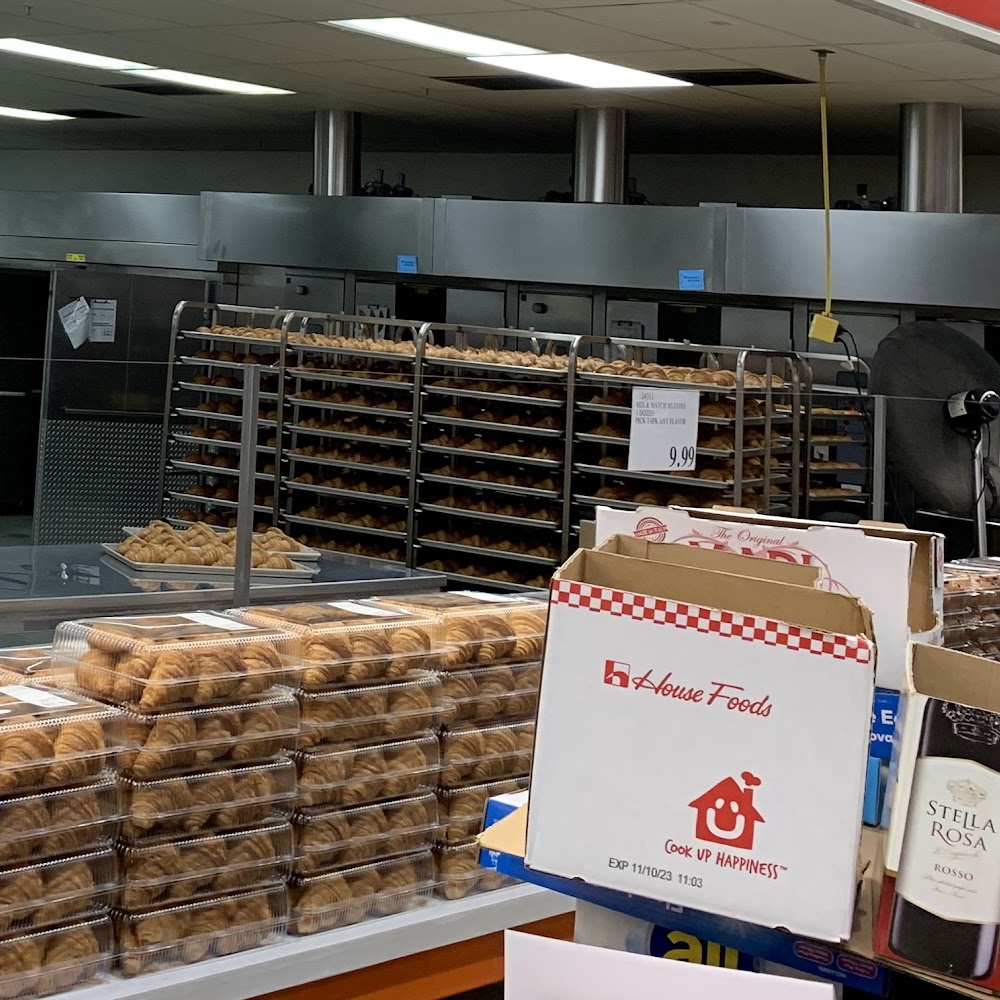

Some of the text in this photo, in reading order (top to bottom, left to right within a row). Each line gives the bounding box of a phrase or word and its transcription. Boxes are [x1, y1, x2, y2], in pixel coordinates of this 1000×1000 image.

[669, 445, 695, 468] 9.99
[710, 526, 786, 548] The Original
[632, 669, 773, 718] House Foods
[926, 800, 996, 834] STELLA
[930, 821, 988, 852] ROSA
[697, 848, 712, 863] UP
[608, 857, 704, 888] EXP 11/10/23 11:03
[933, 863, 974, 881] ROSSO
[662, 930, 739, 970] all
